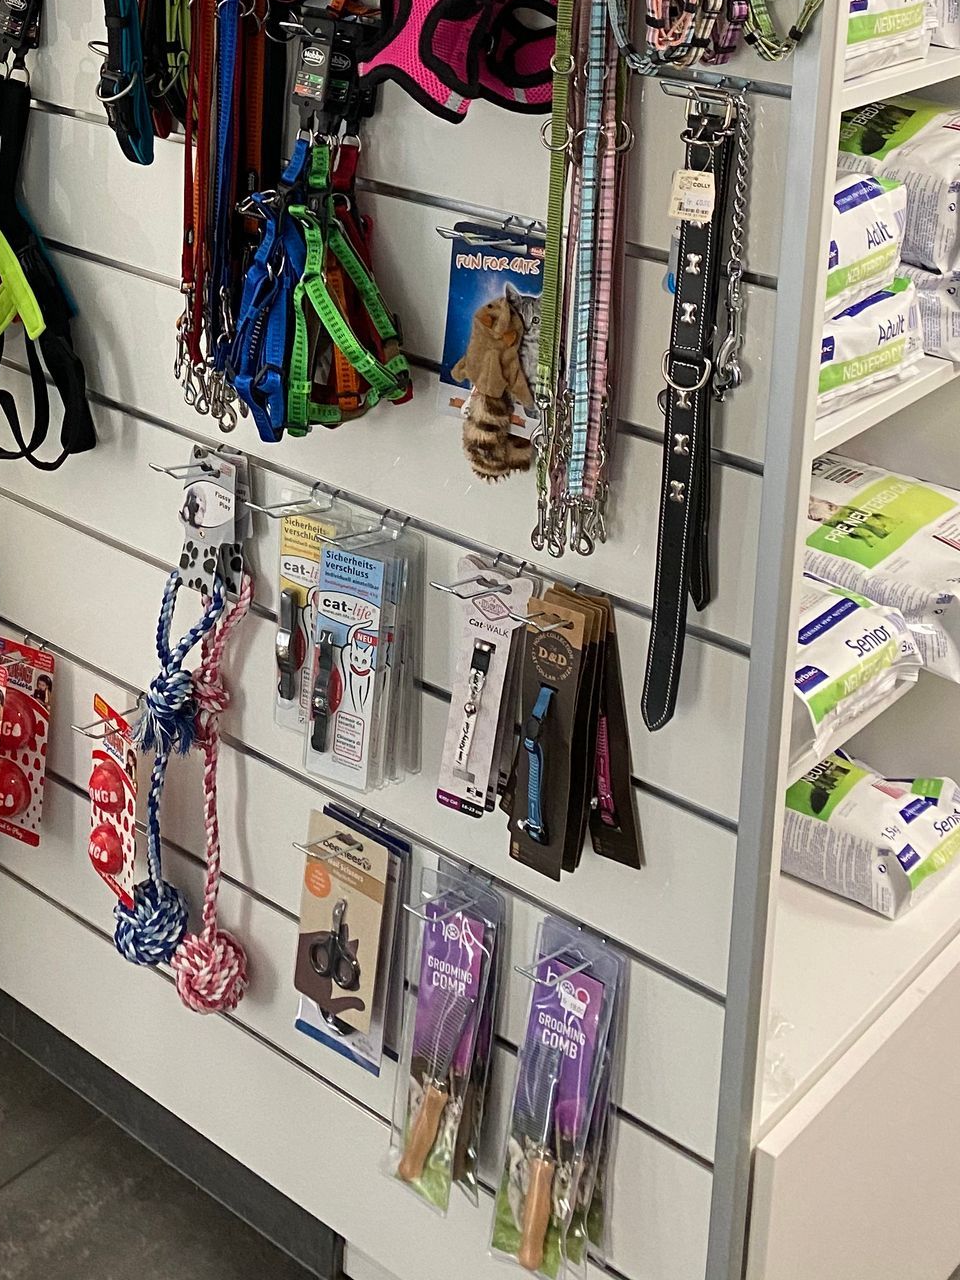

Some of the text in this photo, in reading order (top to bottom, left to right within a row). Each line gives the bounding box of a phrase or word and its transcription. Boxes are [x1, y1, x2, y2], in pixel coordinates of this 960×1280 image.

[304, 48, 324, 64] Nobby
[456, 252, 541, 275] FUN FOR CATS
[878, 314, 905, 346] Adult
[215, 490, 232, 504] Flossy
[219, 501, 232, 512] Play
[824, 520, 855, 544] PRE
[283, 561, 319, 580] cat-li
[325, 561, 369, 580] verschluss
[326, 550, 377, 571] Sicherheits-
[356, 632, 373, 644] NEU
[469, 618, 509, 639] Cat-WALK
[845, 625, 891, 658] Senior
[538, 646, 568, 667] D&D
[7, 677, 34, 693] nature
[427, 955, 473, 985] GROOMING
[538, 1012, 586, 1046] GROOMING
[542, 1028, 578, 1060] COMB
